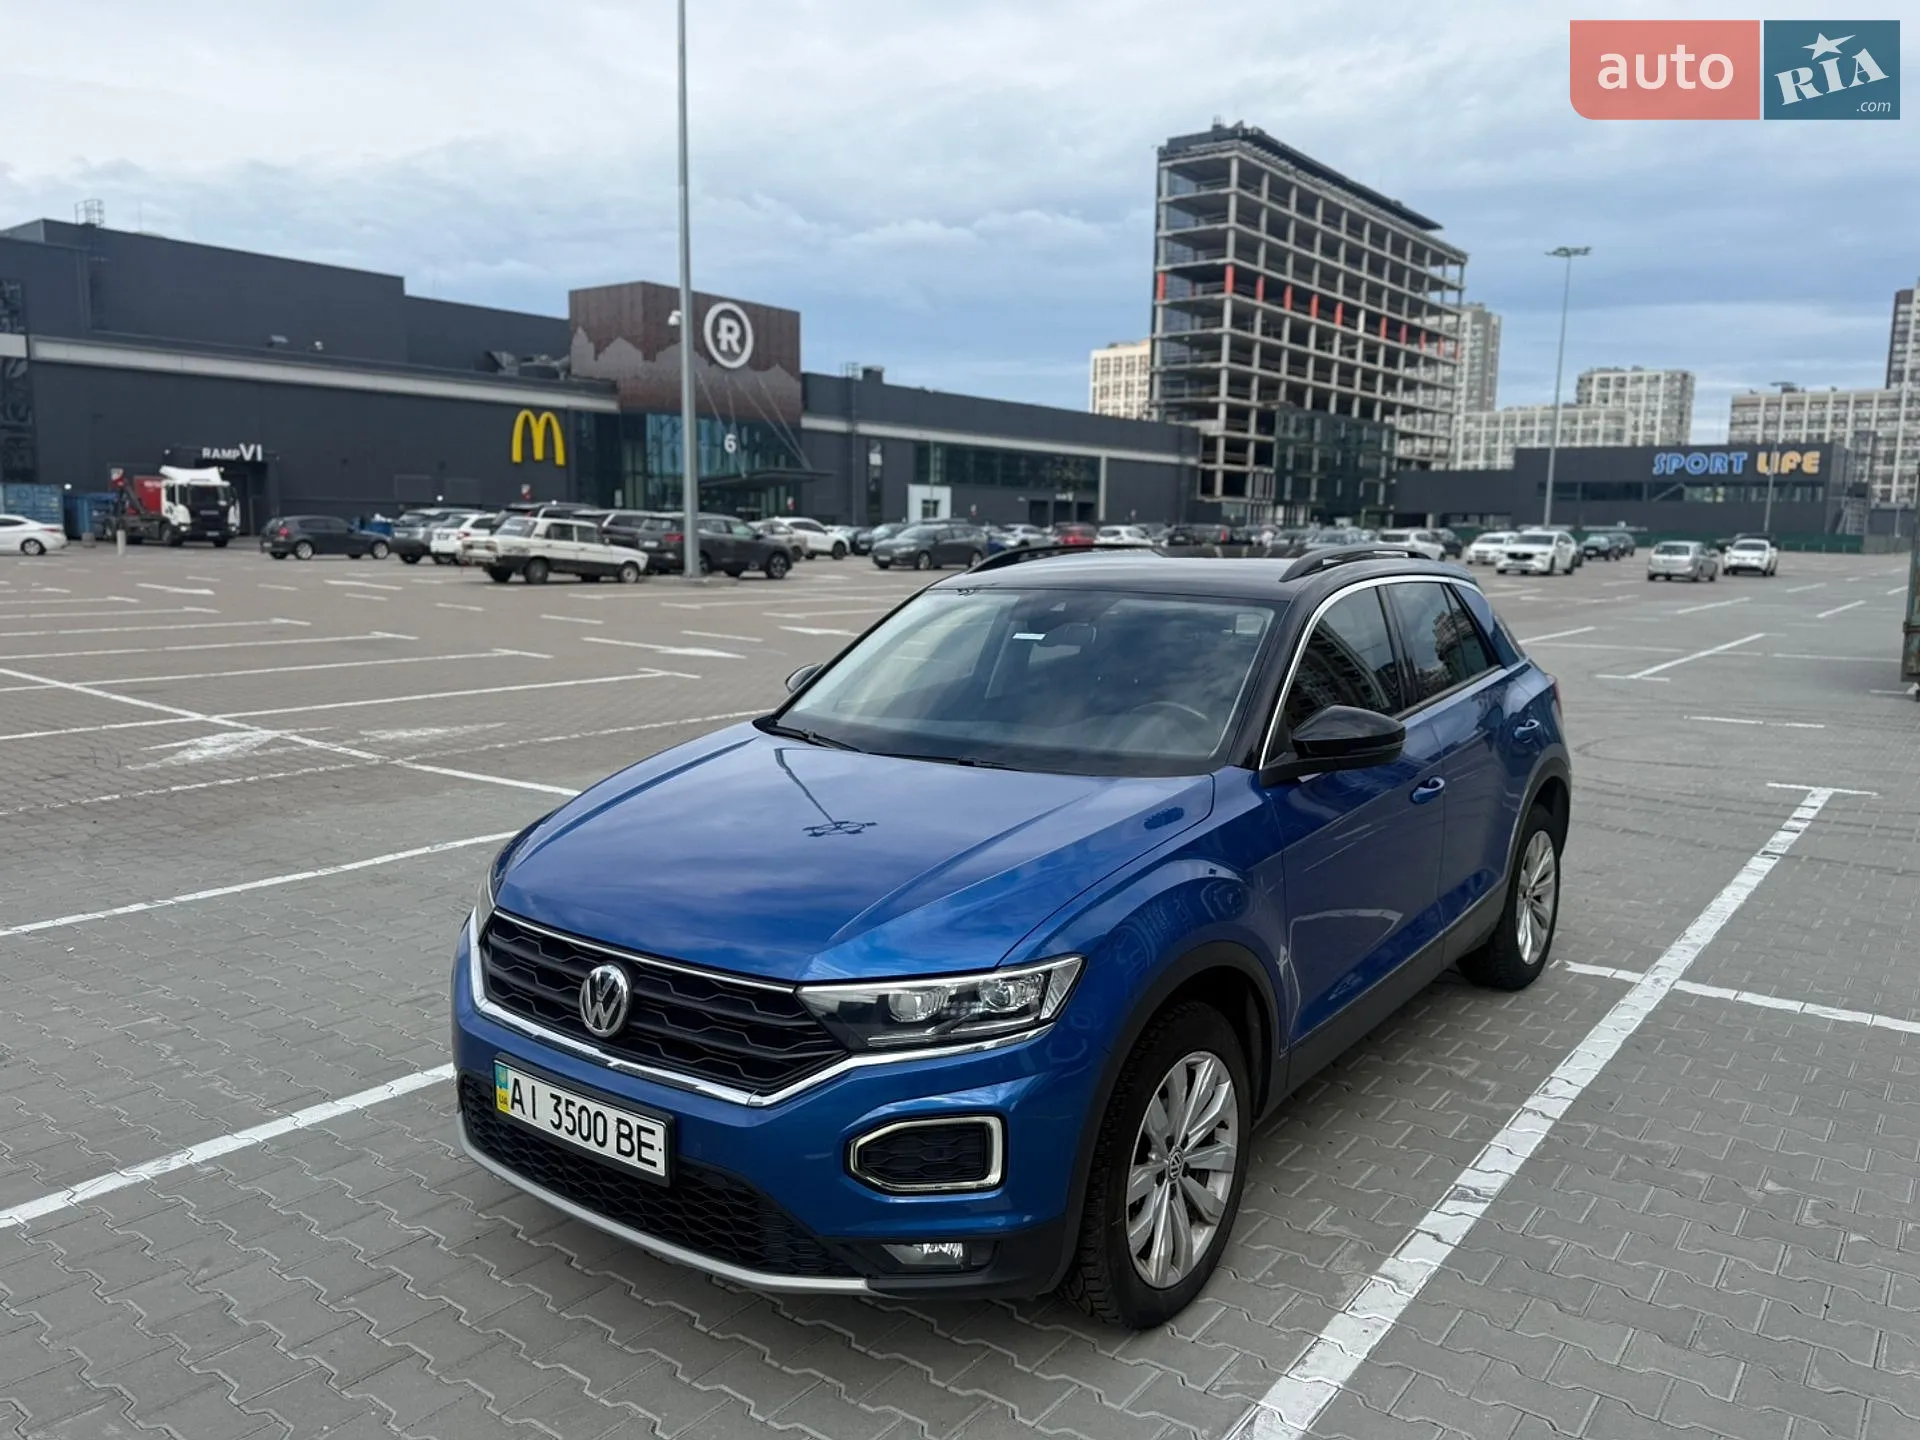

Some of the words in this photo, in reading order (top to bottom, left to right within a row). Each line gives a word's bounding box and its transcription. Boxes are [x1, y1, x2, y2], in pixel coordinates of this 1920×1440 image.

[201, 447, 241, 460] RAMP
[238, 442, 263, 462] VI
[723, 432, 737, 454] 6
[1652, 452, 1748, 475] SPORT
[1756, 450, 1821, 476] LIFE
[510, 1077, 537, 1120] AI
[549, 1092, 608, 1149] 3500
[615, 1116, 658, 1168] BE
